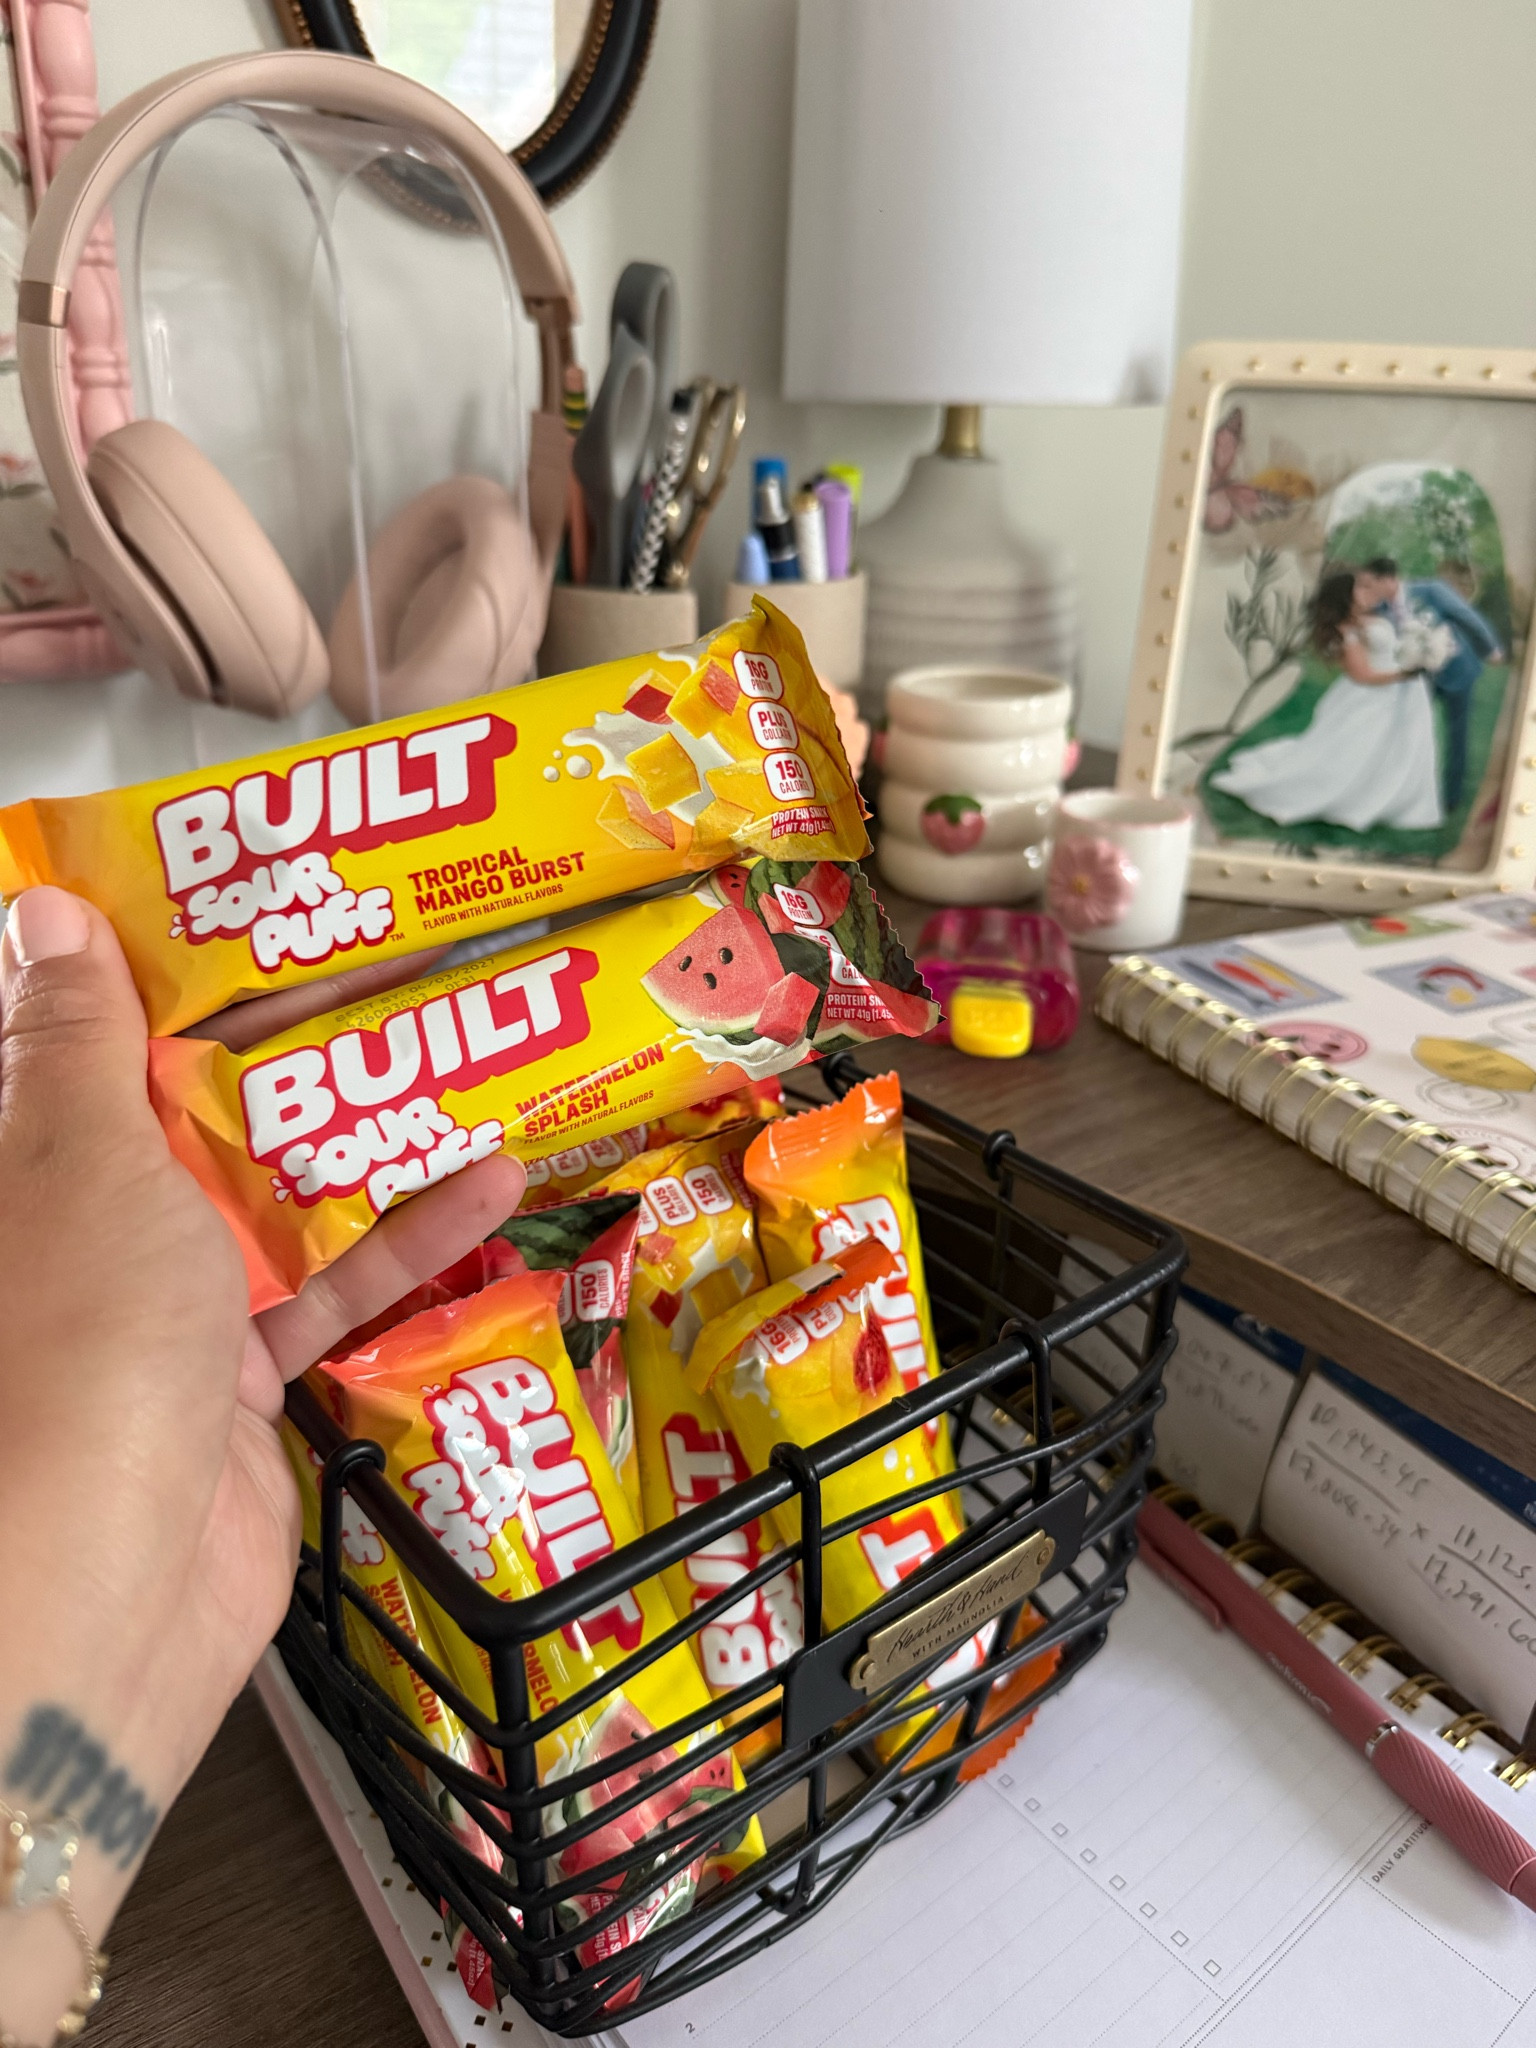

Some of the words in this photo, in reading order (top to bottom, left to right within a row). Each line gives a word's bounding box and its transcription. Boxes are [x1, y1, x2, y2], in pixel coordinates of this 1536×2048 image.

[745, 659, 768, 680] 16G
[758, 711, 787, 728] PLUS
[776, 760, 803, 780] 150
[154, 713, 508, 897] BUILT
[772, 825, 785, 838] NET
[786, 822, 798, 834] WT
[407, 846, 529, 893] TROPICAL
[414, 874, 505, 915] MANGO
[508, 851, 585, 889] BURST
[184, 851, 346, 937] SOUR
[422, 913, 458, 931] FLAVOR
[458, 906, 482, 920] WITH
[484, 895, 525, 914] NATURAL
[525, 883, 564, 902] FLAVORS
[781, 890, 808, 909] 16G
[251, 886, 393, 969] PUFF
[827, 994, 866, 1007] PROTEIN
[827, 1008, 842, 1018] NET
[844, 1008, 855, 1019] WT
[857, 1009, 871, 1021] 41g
[242, 948, 585, 1160] BUILT
[515, 1042, 666, 1121] WATERMELON
[524, 1089, 609, 1138] SPLASH
[524, 1130, 558, 1144] FLAVOR
[558, 1120, 580, 1134] WITH
[581, 1105, 618, 1125] NATURAL
[619, 1089, 655, 1112] FLAVORS
[282, 1096, 455, 1197] SOUR
[653, 1187, 680, 1220] PLUS
[691, 1178, 717, 1207] 150
[581, 1273, 598, 1310] 150
[597, 1268, 610, 1309] CALORIES
[761, 1321, 791, 1354] 16G
[912, 1635, 942, 1661] WITH
[946, 1595, 1005, 1636] MAGNOLIA
[1371, 1858, 1395, 1883] DAILY
[1393, 1817, 1432, 1860] GRATITUDE
[685, 2022, 696, 2034] 2
